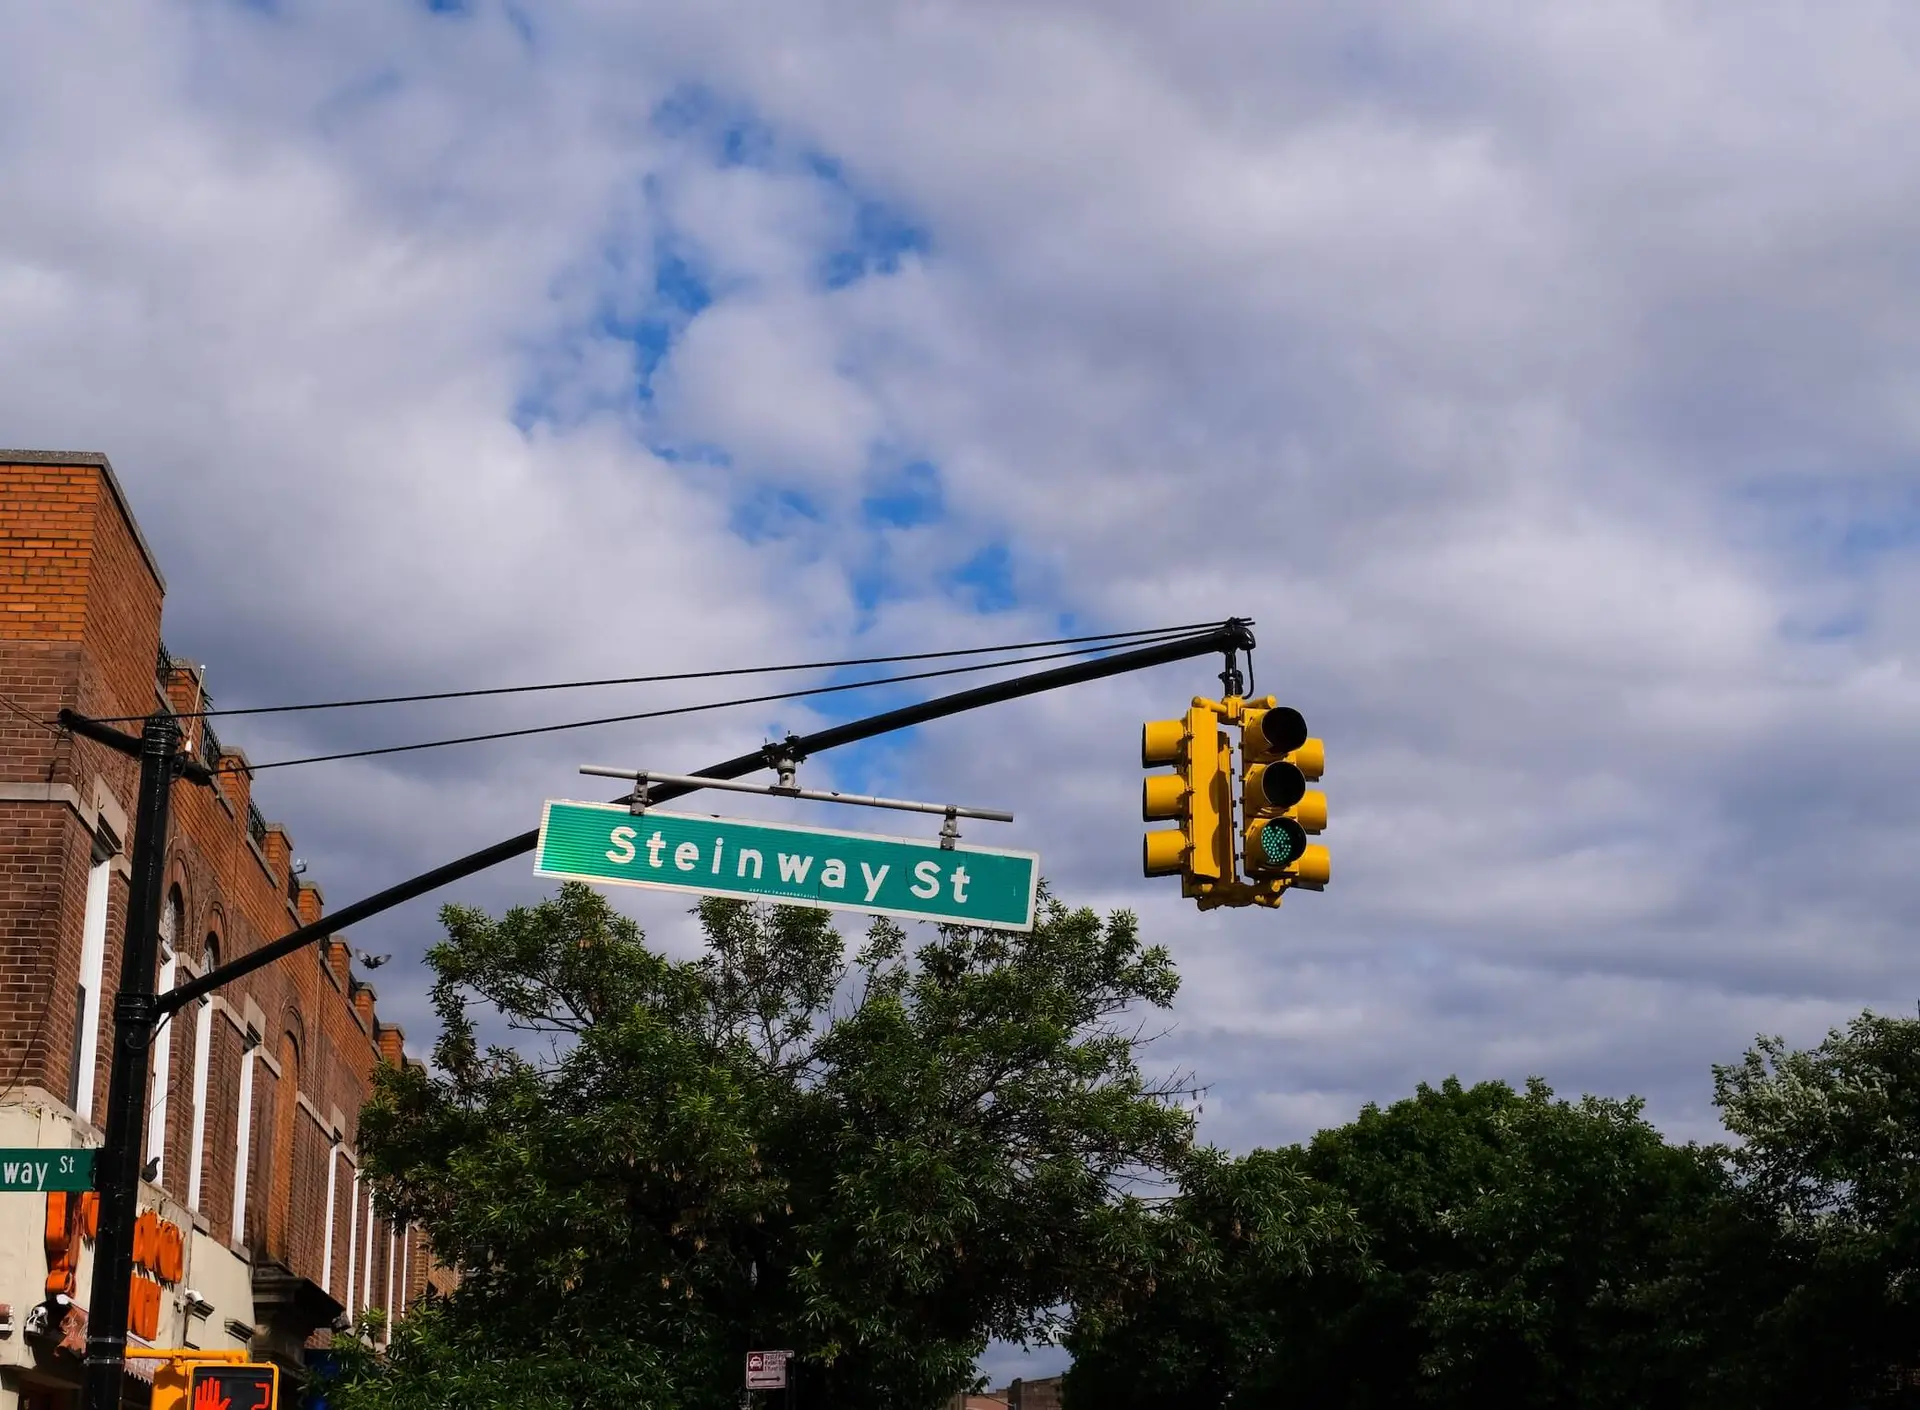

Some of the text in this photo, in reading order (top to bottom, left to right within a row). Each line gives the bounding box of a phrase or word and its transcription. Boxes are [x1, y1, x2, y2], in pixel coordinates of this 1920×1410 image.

[605, 826, 971, 904] Steinway St
[59, 1155, 75, 1174] St
